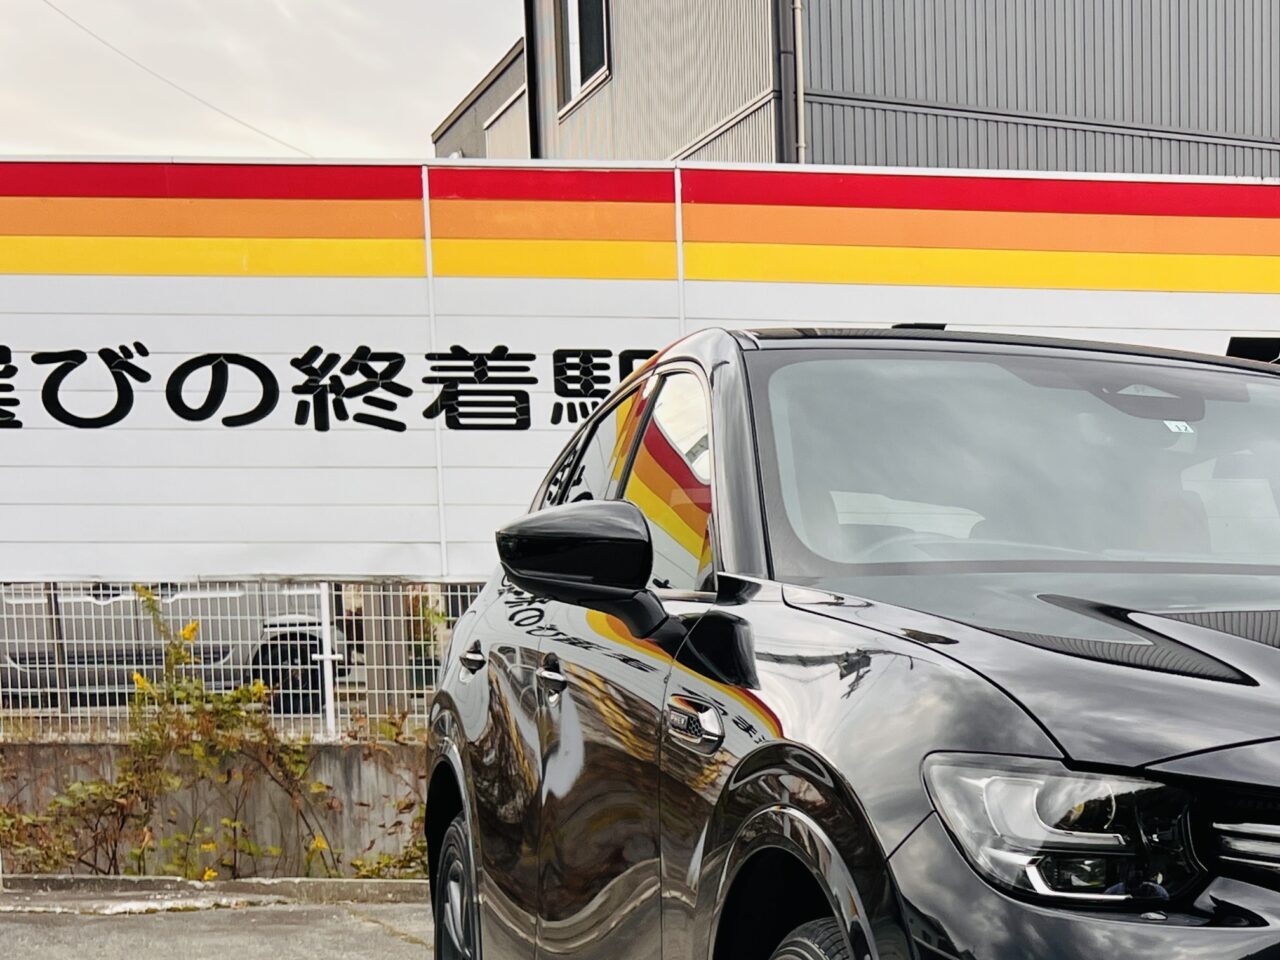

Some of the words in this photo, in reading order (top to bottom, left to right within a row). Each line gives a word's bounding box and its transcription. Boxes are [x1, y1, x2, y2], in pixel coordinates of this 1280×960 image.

[0, 341, 661, 432] びの終着駅
